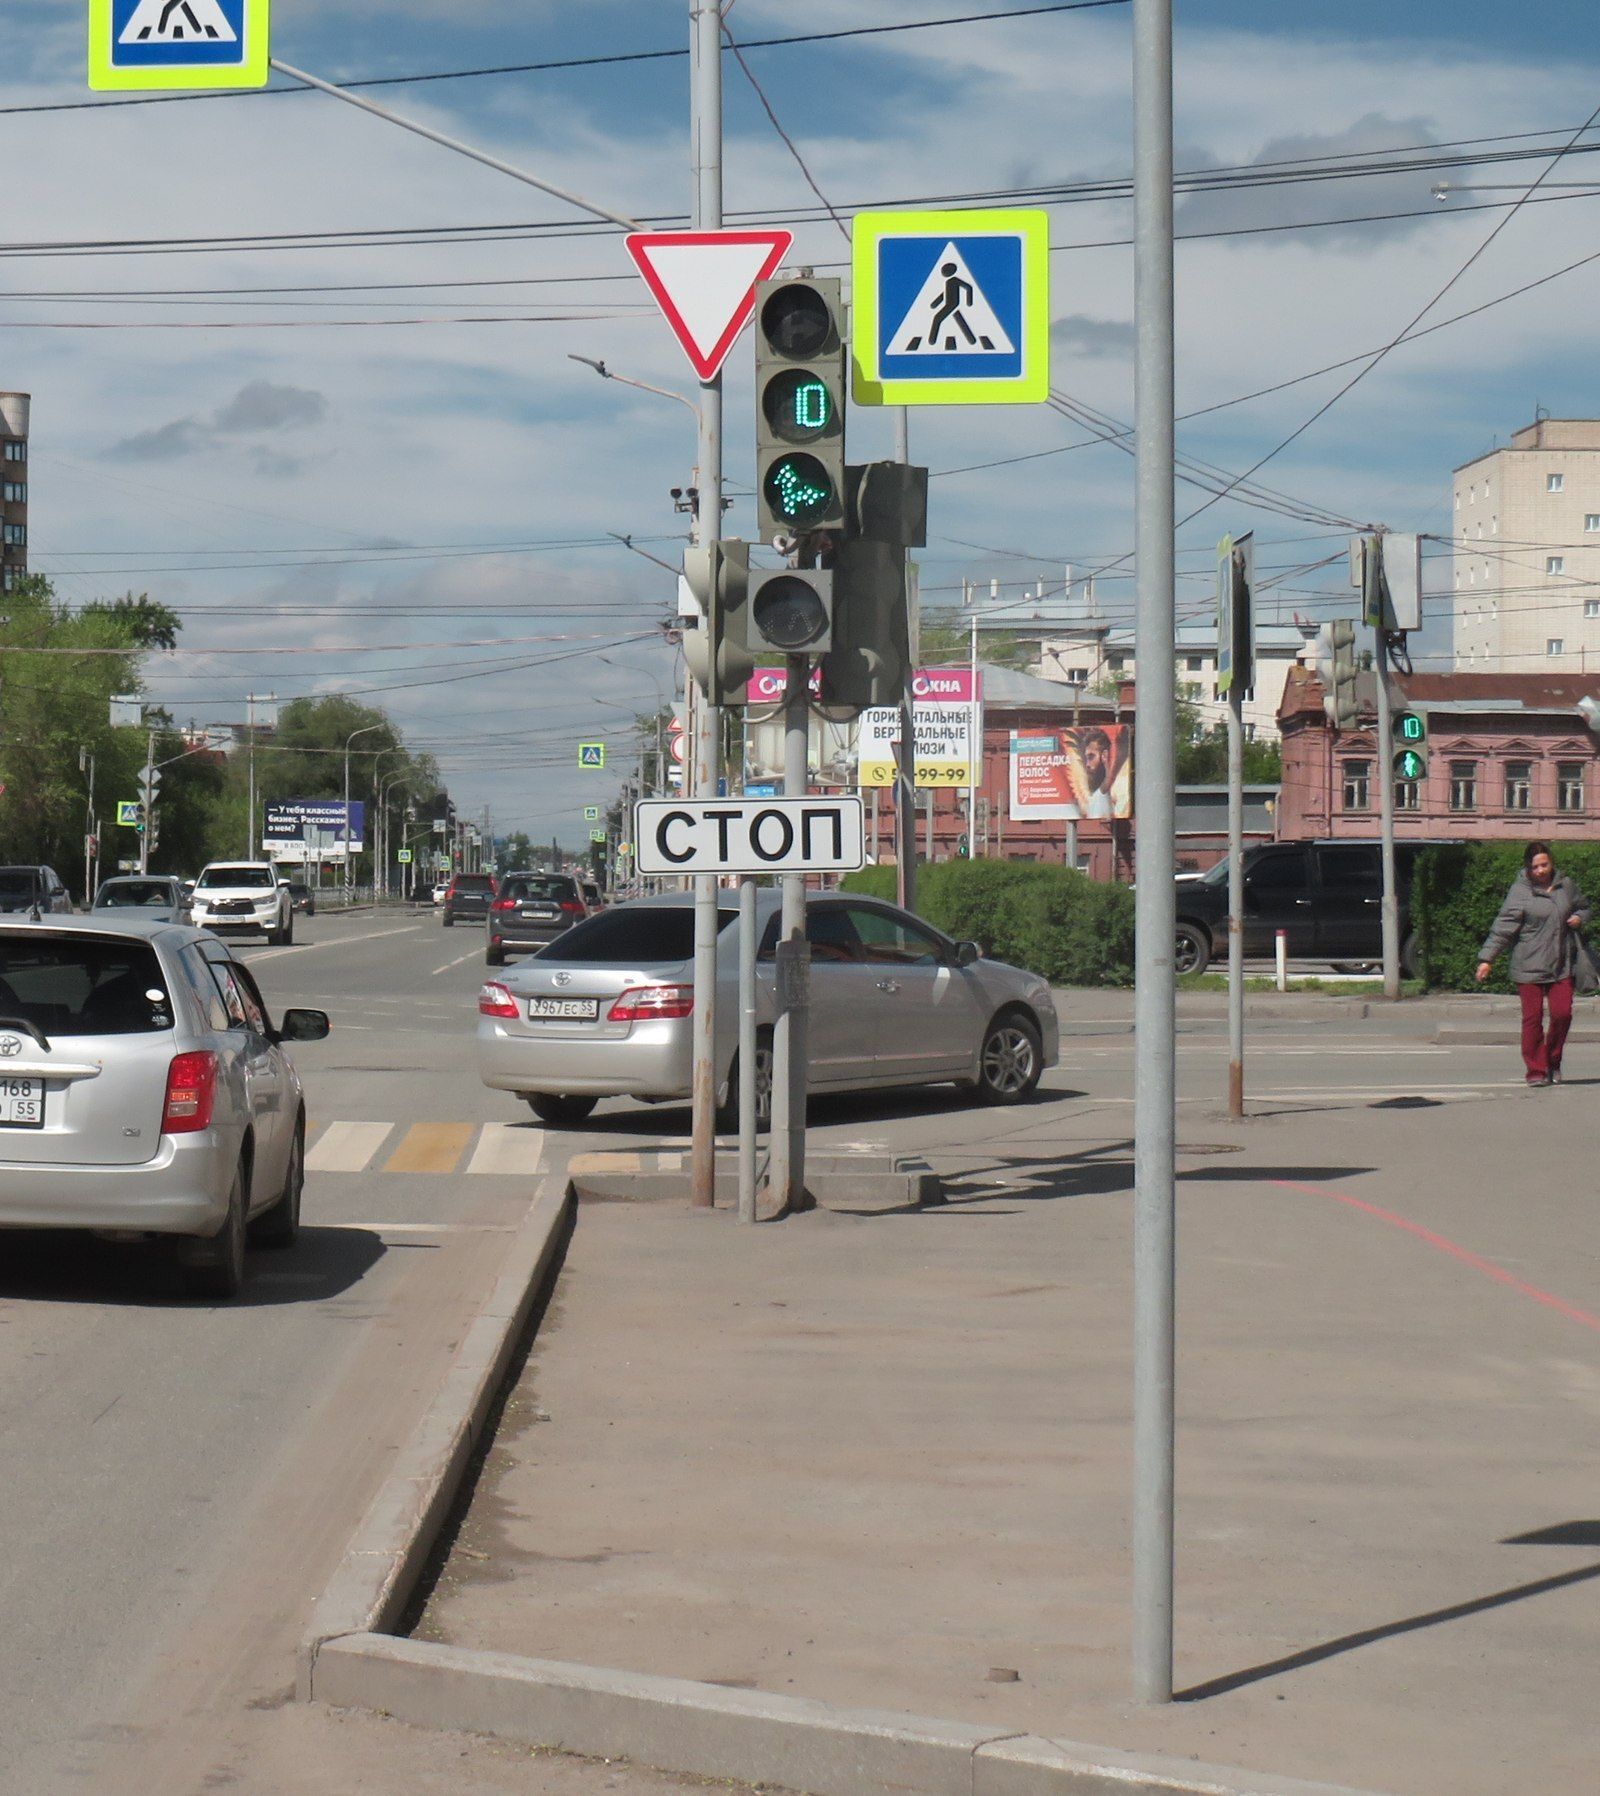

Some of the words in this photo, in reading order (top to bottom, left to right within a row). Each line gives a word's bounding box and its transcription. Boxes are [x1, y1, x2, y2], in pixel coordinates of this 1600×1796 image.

[796, 384, 825, 428] 10
[867, 710, 972, 724] ГОРИЗНТАЛЬНЫЕ
[1404, 718, 1419, 738] 10
[1019, 755, 1071, 767] ПЕРЕСАДКА
[1019, 767, 1050, 778] ВОЛОС
[278, 805, 286, 814] У
[286, 805, 305, 814] тебя
[656, 808, 842, 864] СТОП
[17, 1101, 35, 1115] 55
